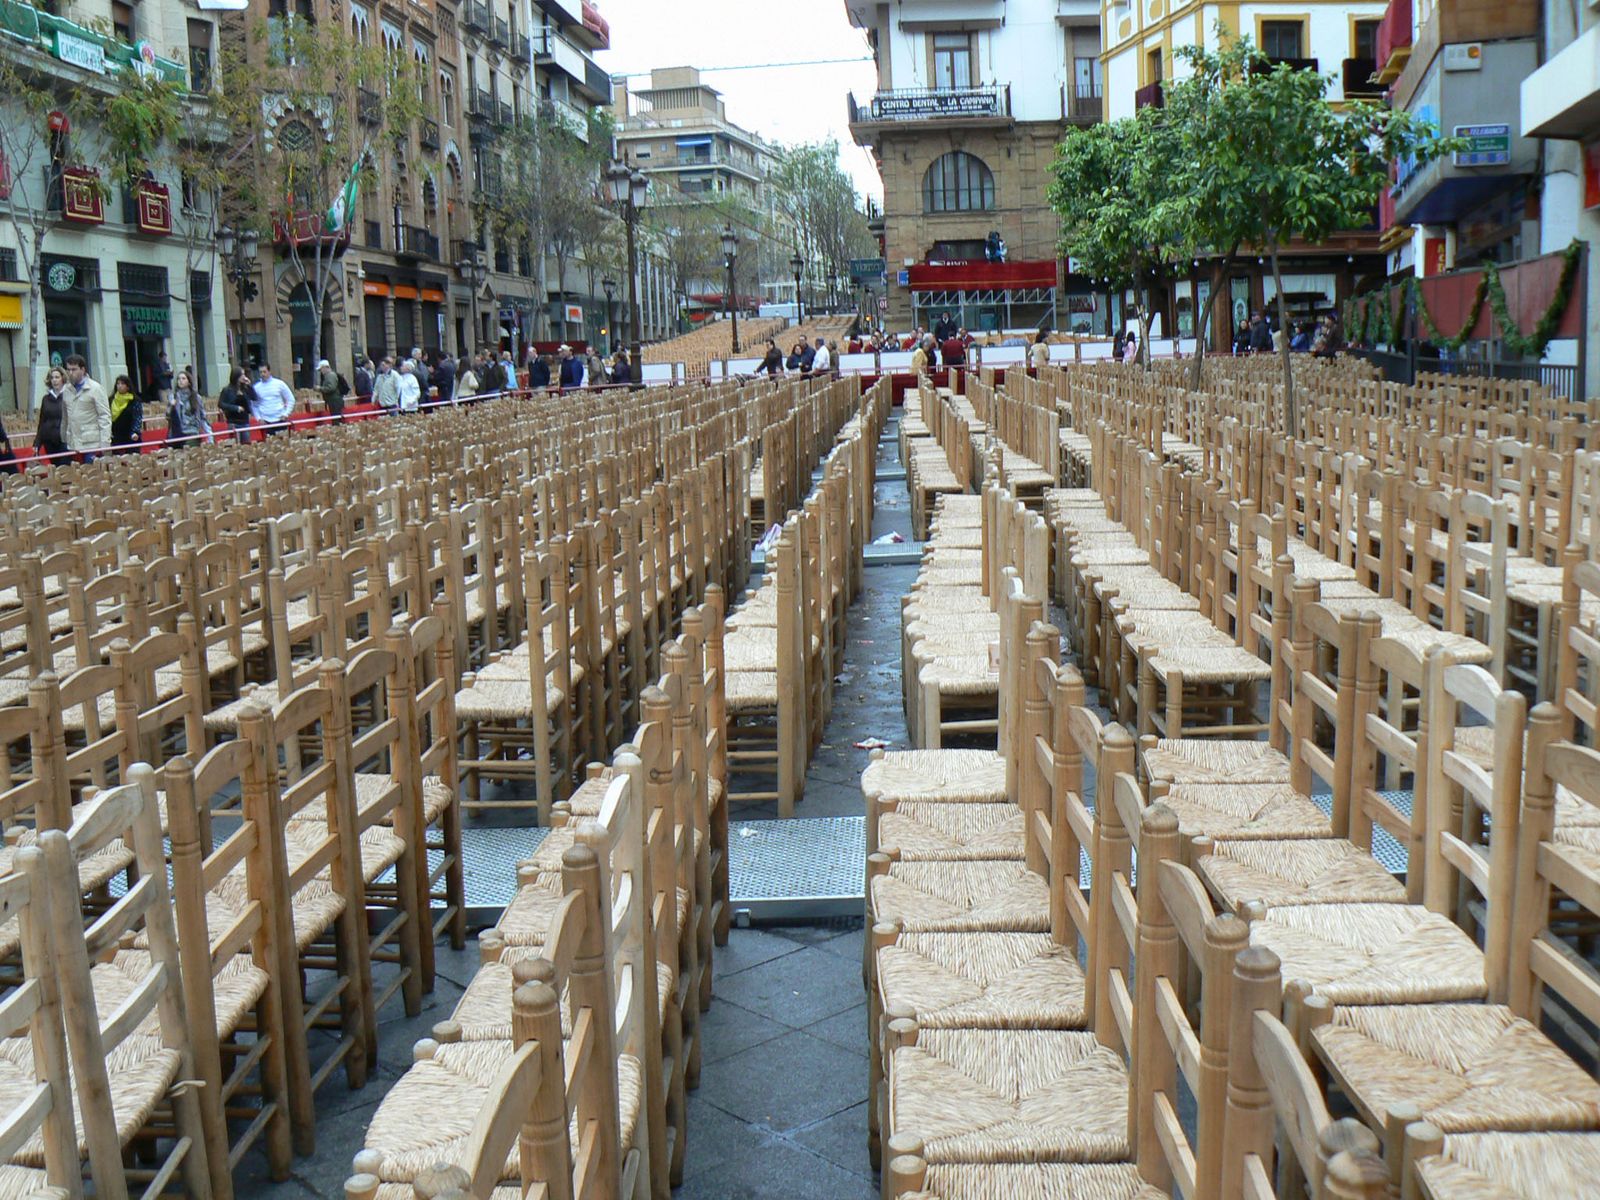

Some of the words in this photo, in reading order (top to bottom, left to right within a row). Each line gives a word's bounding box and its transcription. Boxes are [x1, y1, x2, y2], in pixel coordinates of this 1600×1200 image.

[882, 99, 910, 109] CENTRO
[913, 98, 939, 108] DENTAL
[948, 97, 957, 106] LA
[960, 96, 994, 106] CAMPANA
[127, 306, 170, 321] STARBUCKS
[136, 322, 163, 336] COFFEE
